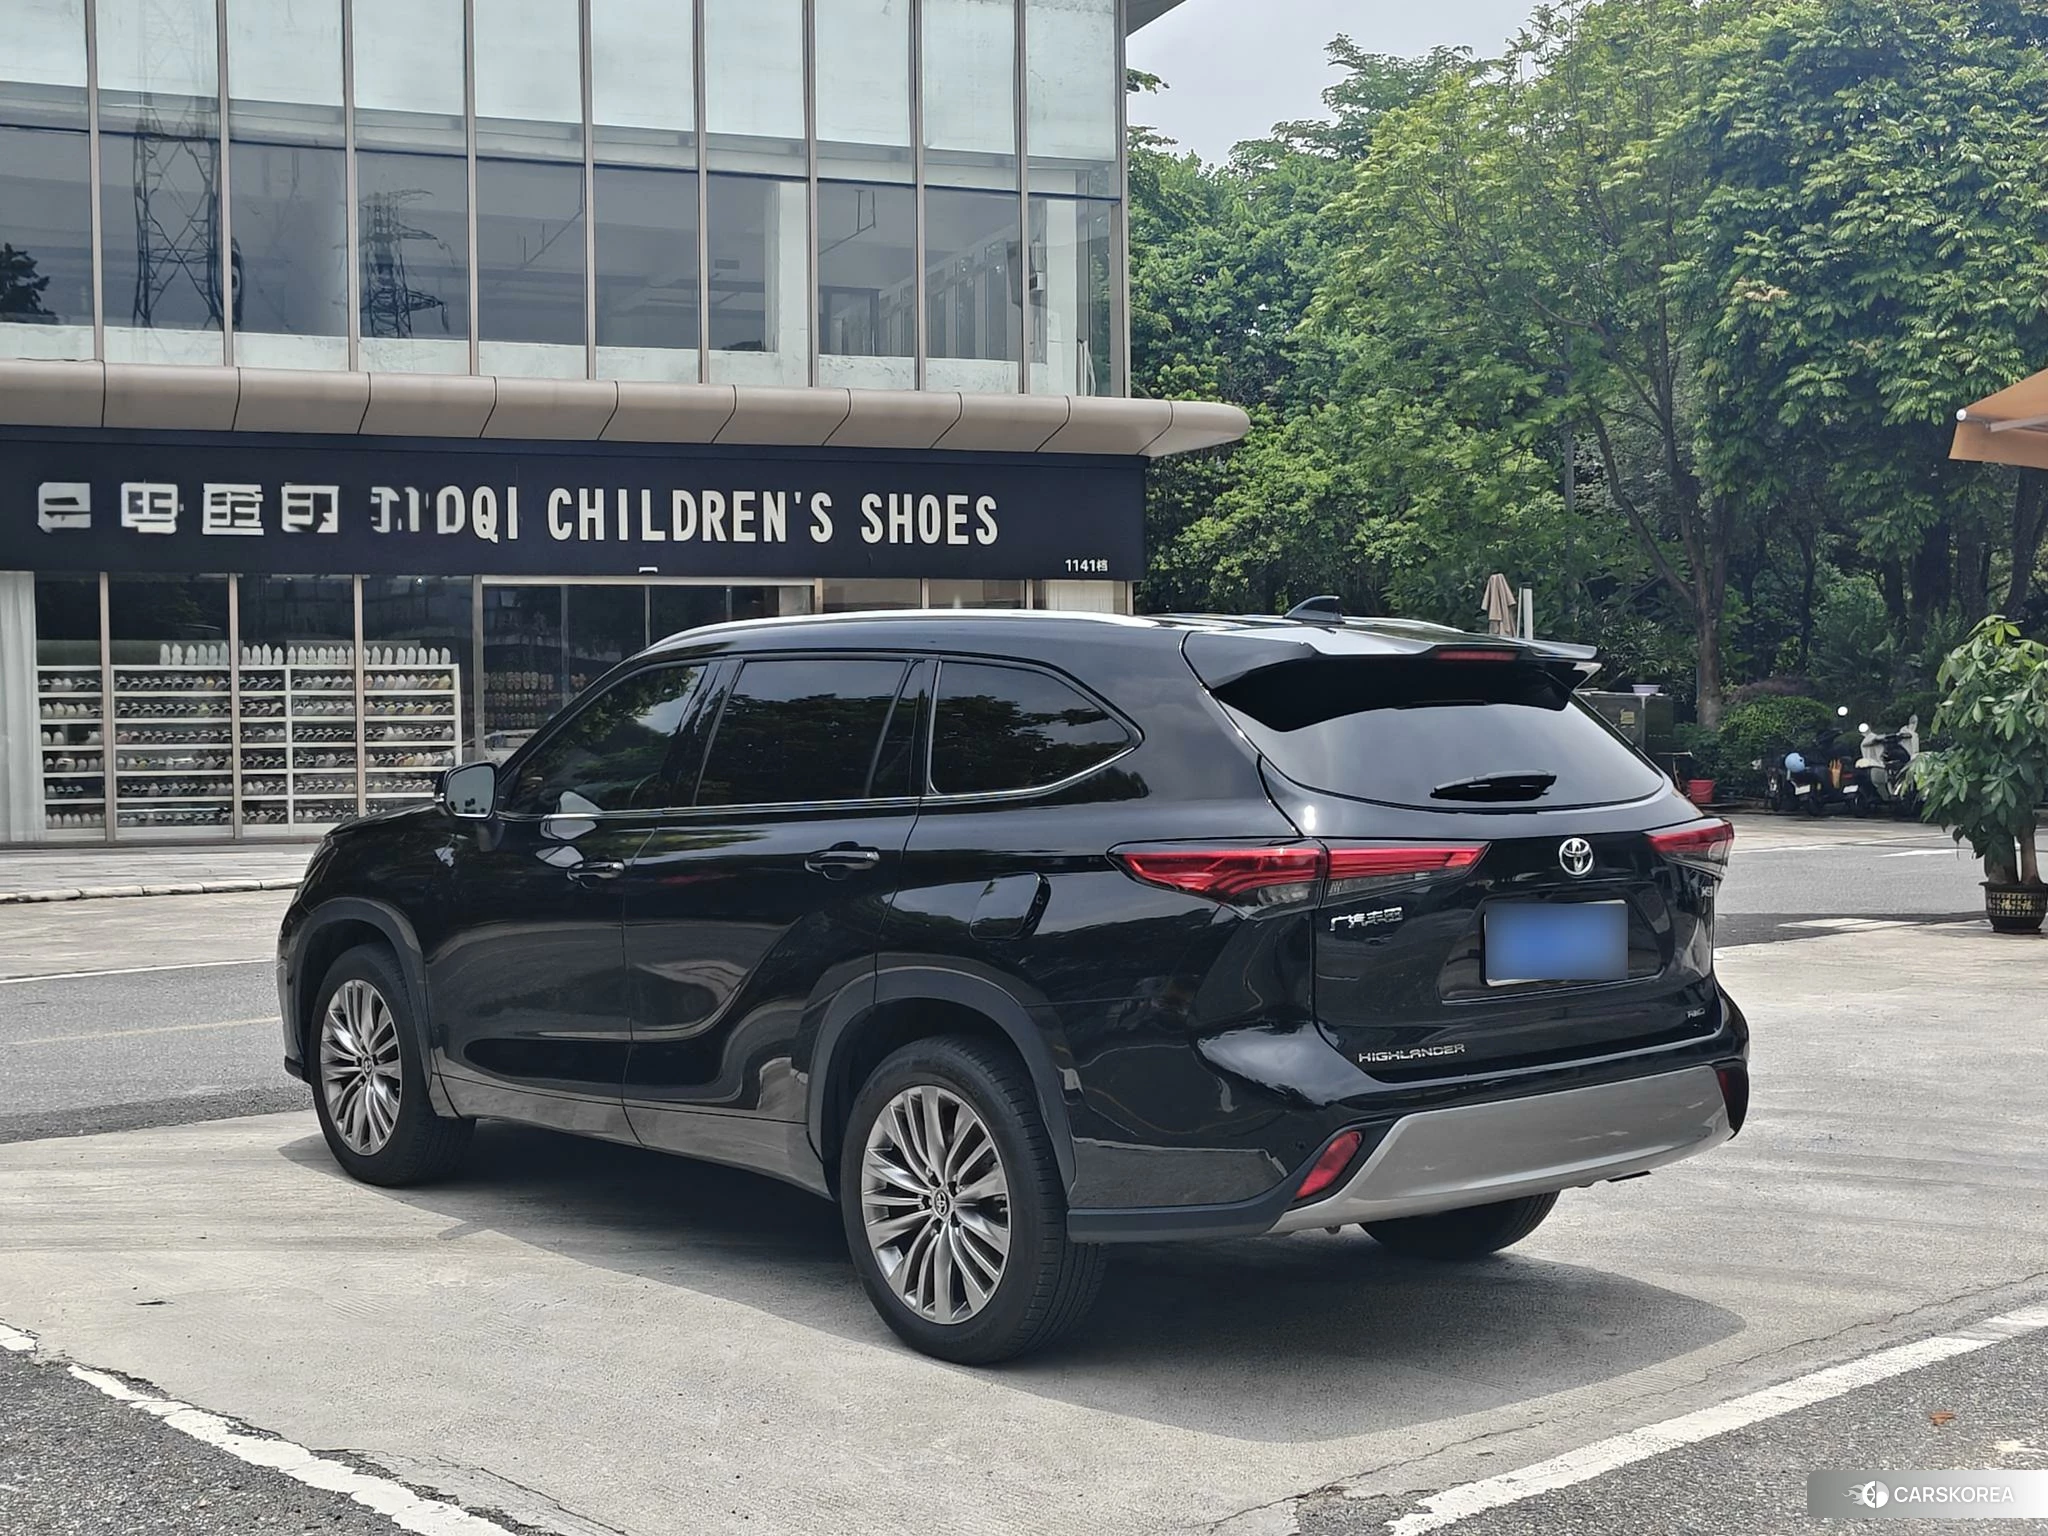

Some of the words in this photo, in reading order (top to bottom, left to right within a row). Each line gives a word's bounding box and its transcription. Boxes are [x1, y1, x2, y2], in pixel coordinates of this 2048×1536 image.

[547, 487, 833, 543] CHILDREN'S
[860, 493, 998, 545] SHOES
[1358, 1043, 1466, 1063] HIGHLANDER
